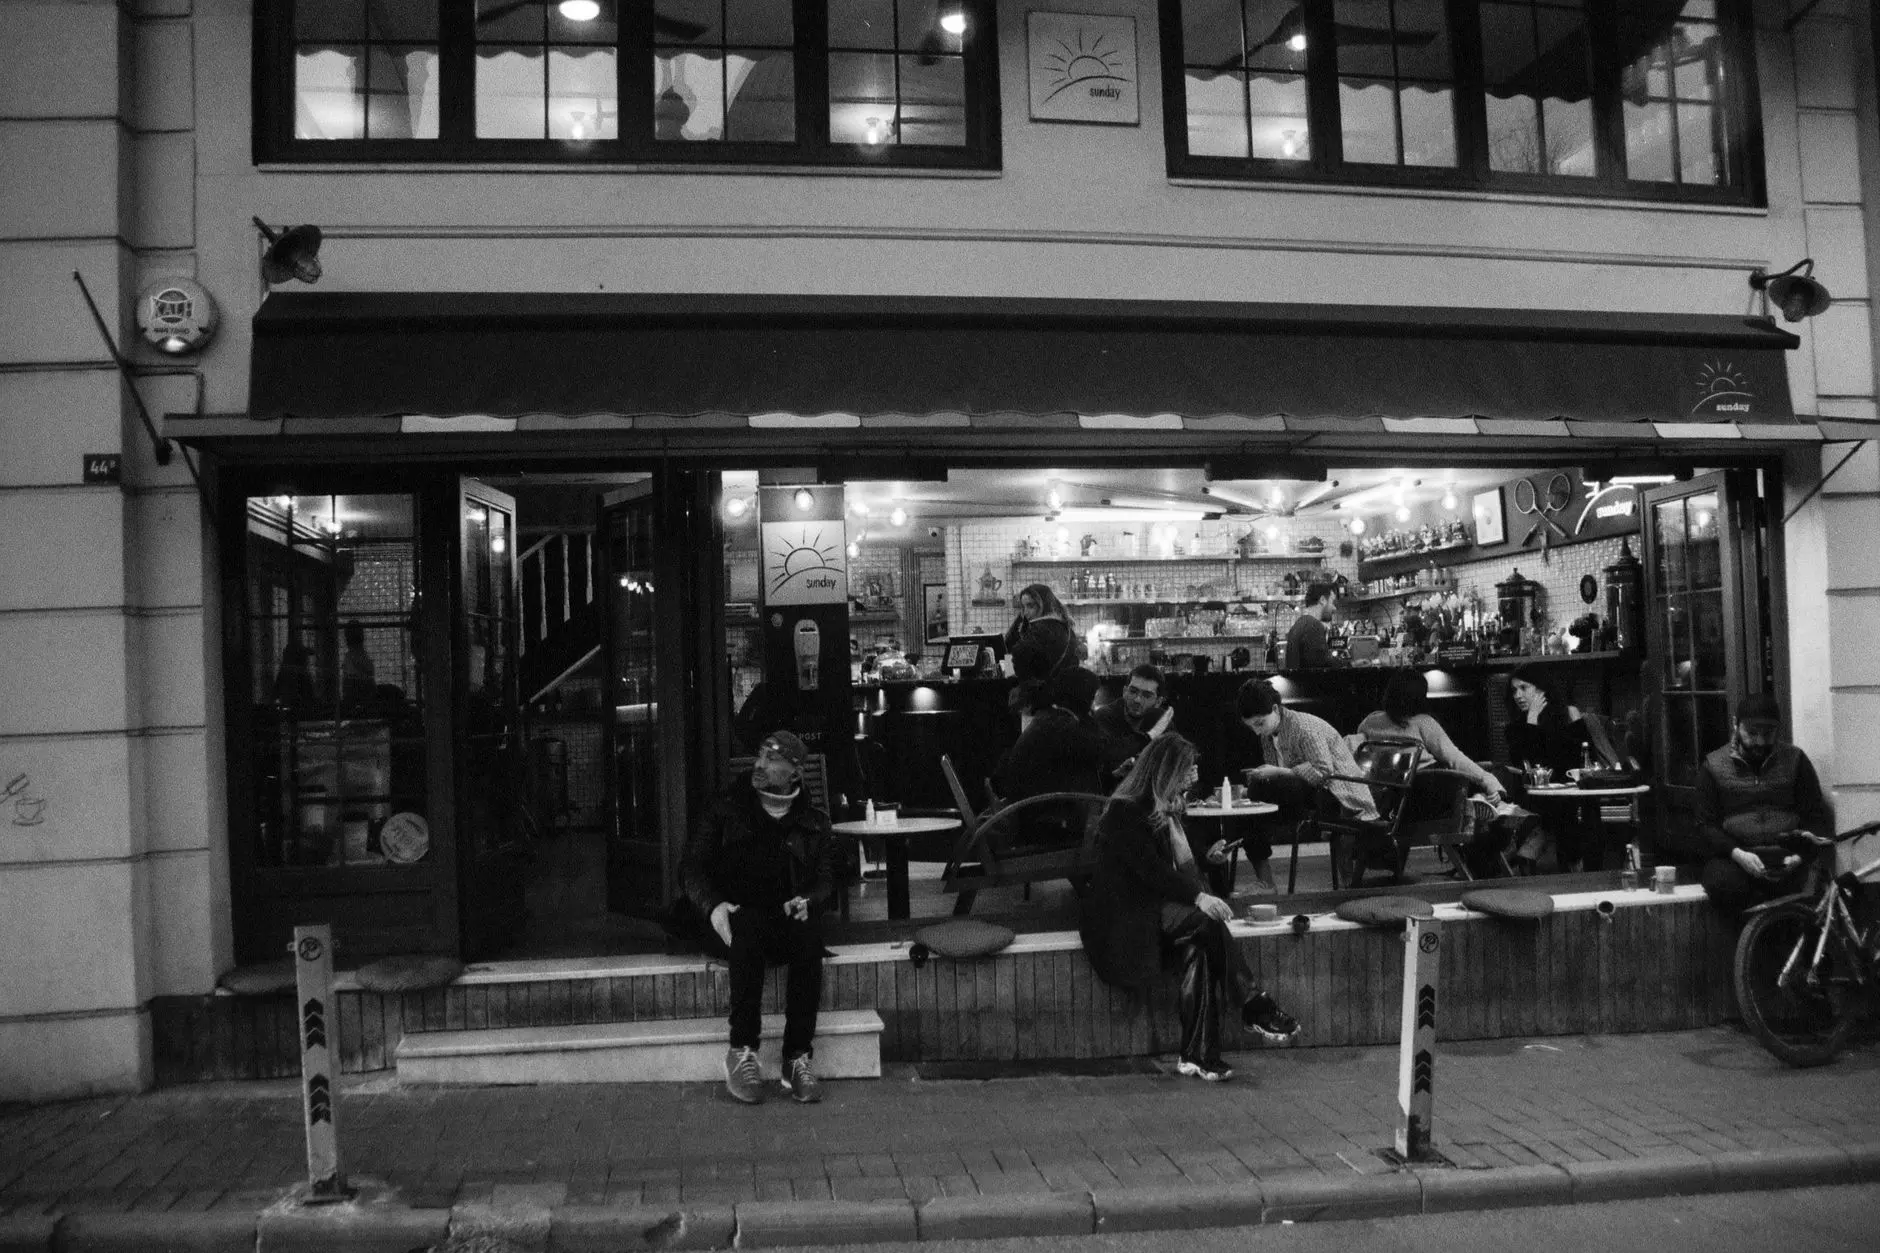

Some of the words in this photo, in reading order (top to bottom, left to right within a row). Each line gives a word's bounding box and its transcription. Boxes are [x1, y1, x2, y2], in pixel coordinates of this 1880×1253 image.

[1089, 85, 1121, 100] sunday
[1596, 500, 1632, 519] sunday
[806, 575, 837, 590] sunday
